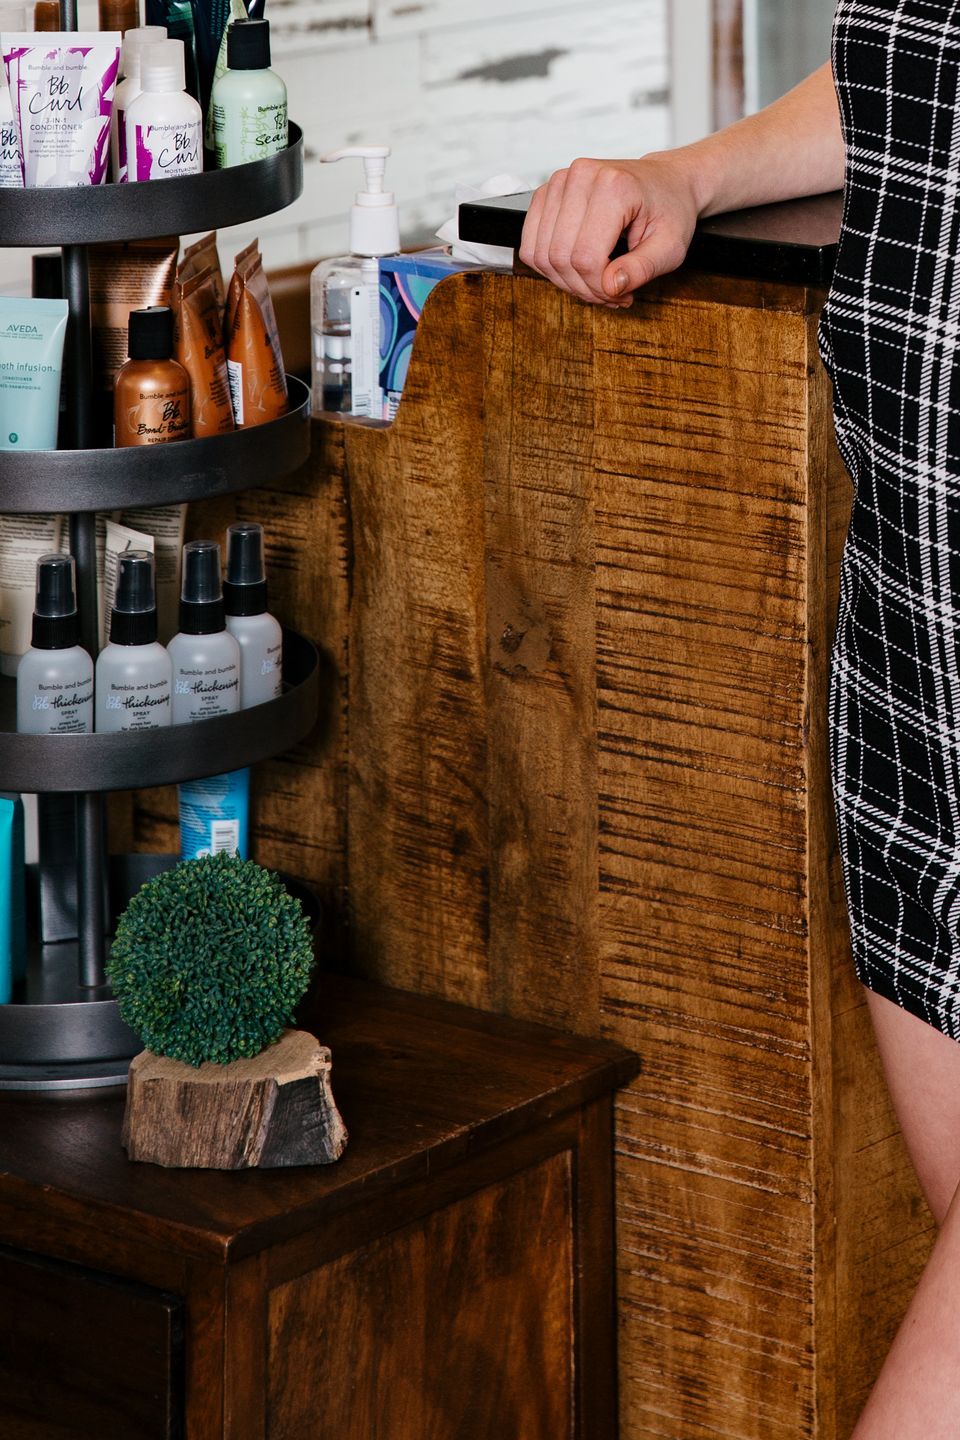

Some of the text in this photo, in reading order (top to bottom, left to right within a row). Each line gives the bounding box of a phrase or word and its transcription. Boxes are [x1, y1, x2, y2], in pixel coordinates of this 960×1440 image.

[29, 87, 84, 115] Curl
[158, 140, 199, 168] Curl
[7, 325, 38, 333] AVEDA
[0, 362, 14, 370] oth
[190, 678, 239, 694] thickening
[50, 693, 94, 709] thicken
[122, 694, 170, 709] thickening
